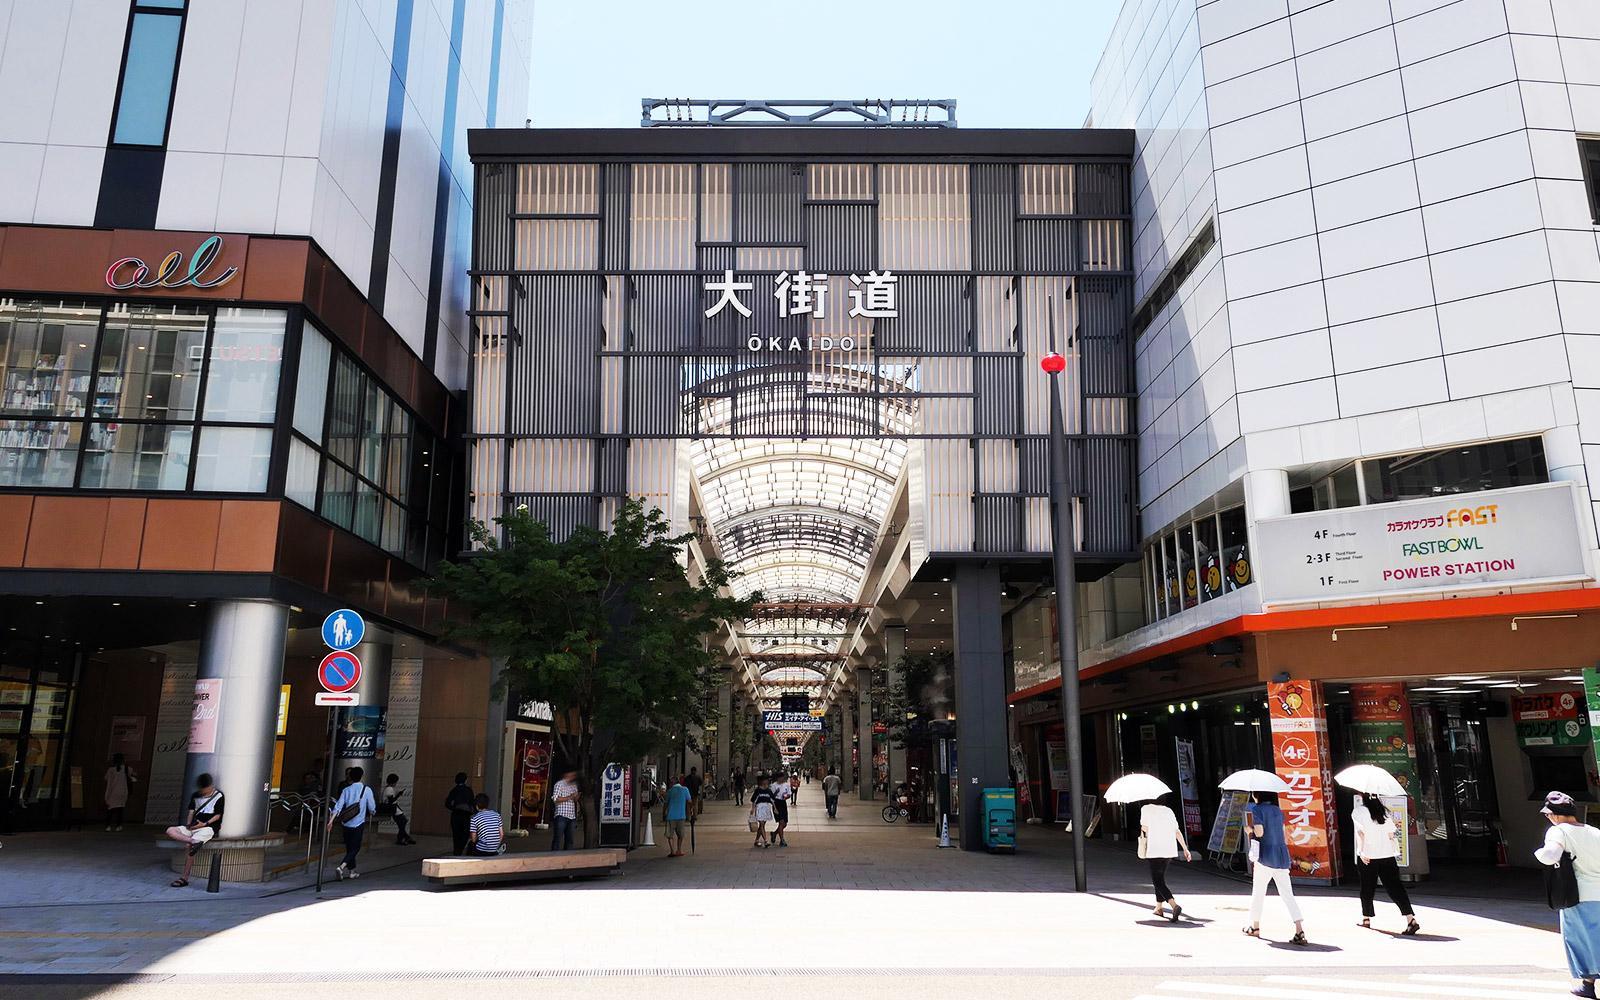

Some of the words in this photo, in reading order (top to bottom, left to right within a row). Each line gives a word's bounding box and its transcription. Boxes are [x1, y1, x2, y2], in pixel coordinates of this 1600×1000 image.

[704, 270, 898, 319] 大街道
[1387, 515, 1444, 532] カラオケクラブ
[1447, 504, 1498, 528] FAST
[1383, 566, 1441, 581] POWER
[1445, 558, 1515, 576] STATION
[766, 711, 784, 721] HIS
[346, 736, 373, 748] HIS
[1283, 745, 1307, 760] 4F
[613, 782, 621, 816] 歩行者
[1285, 770, 1318, 846] カラオケ
